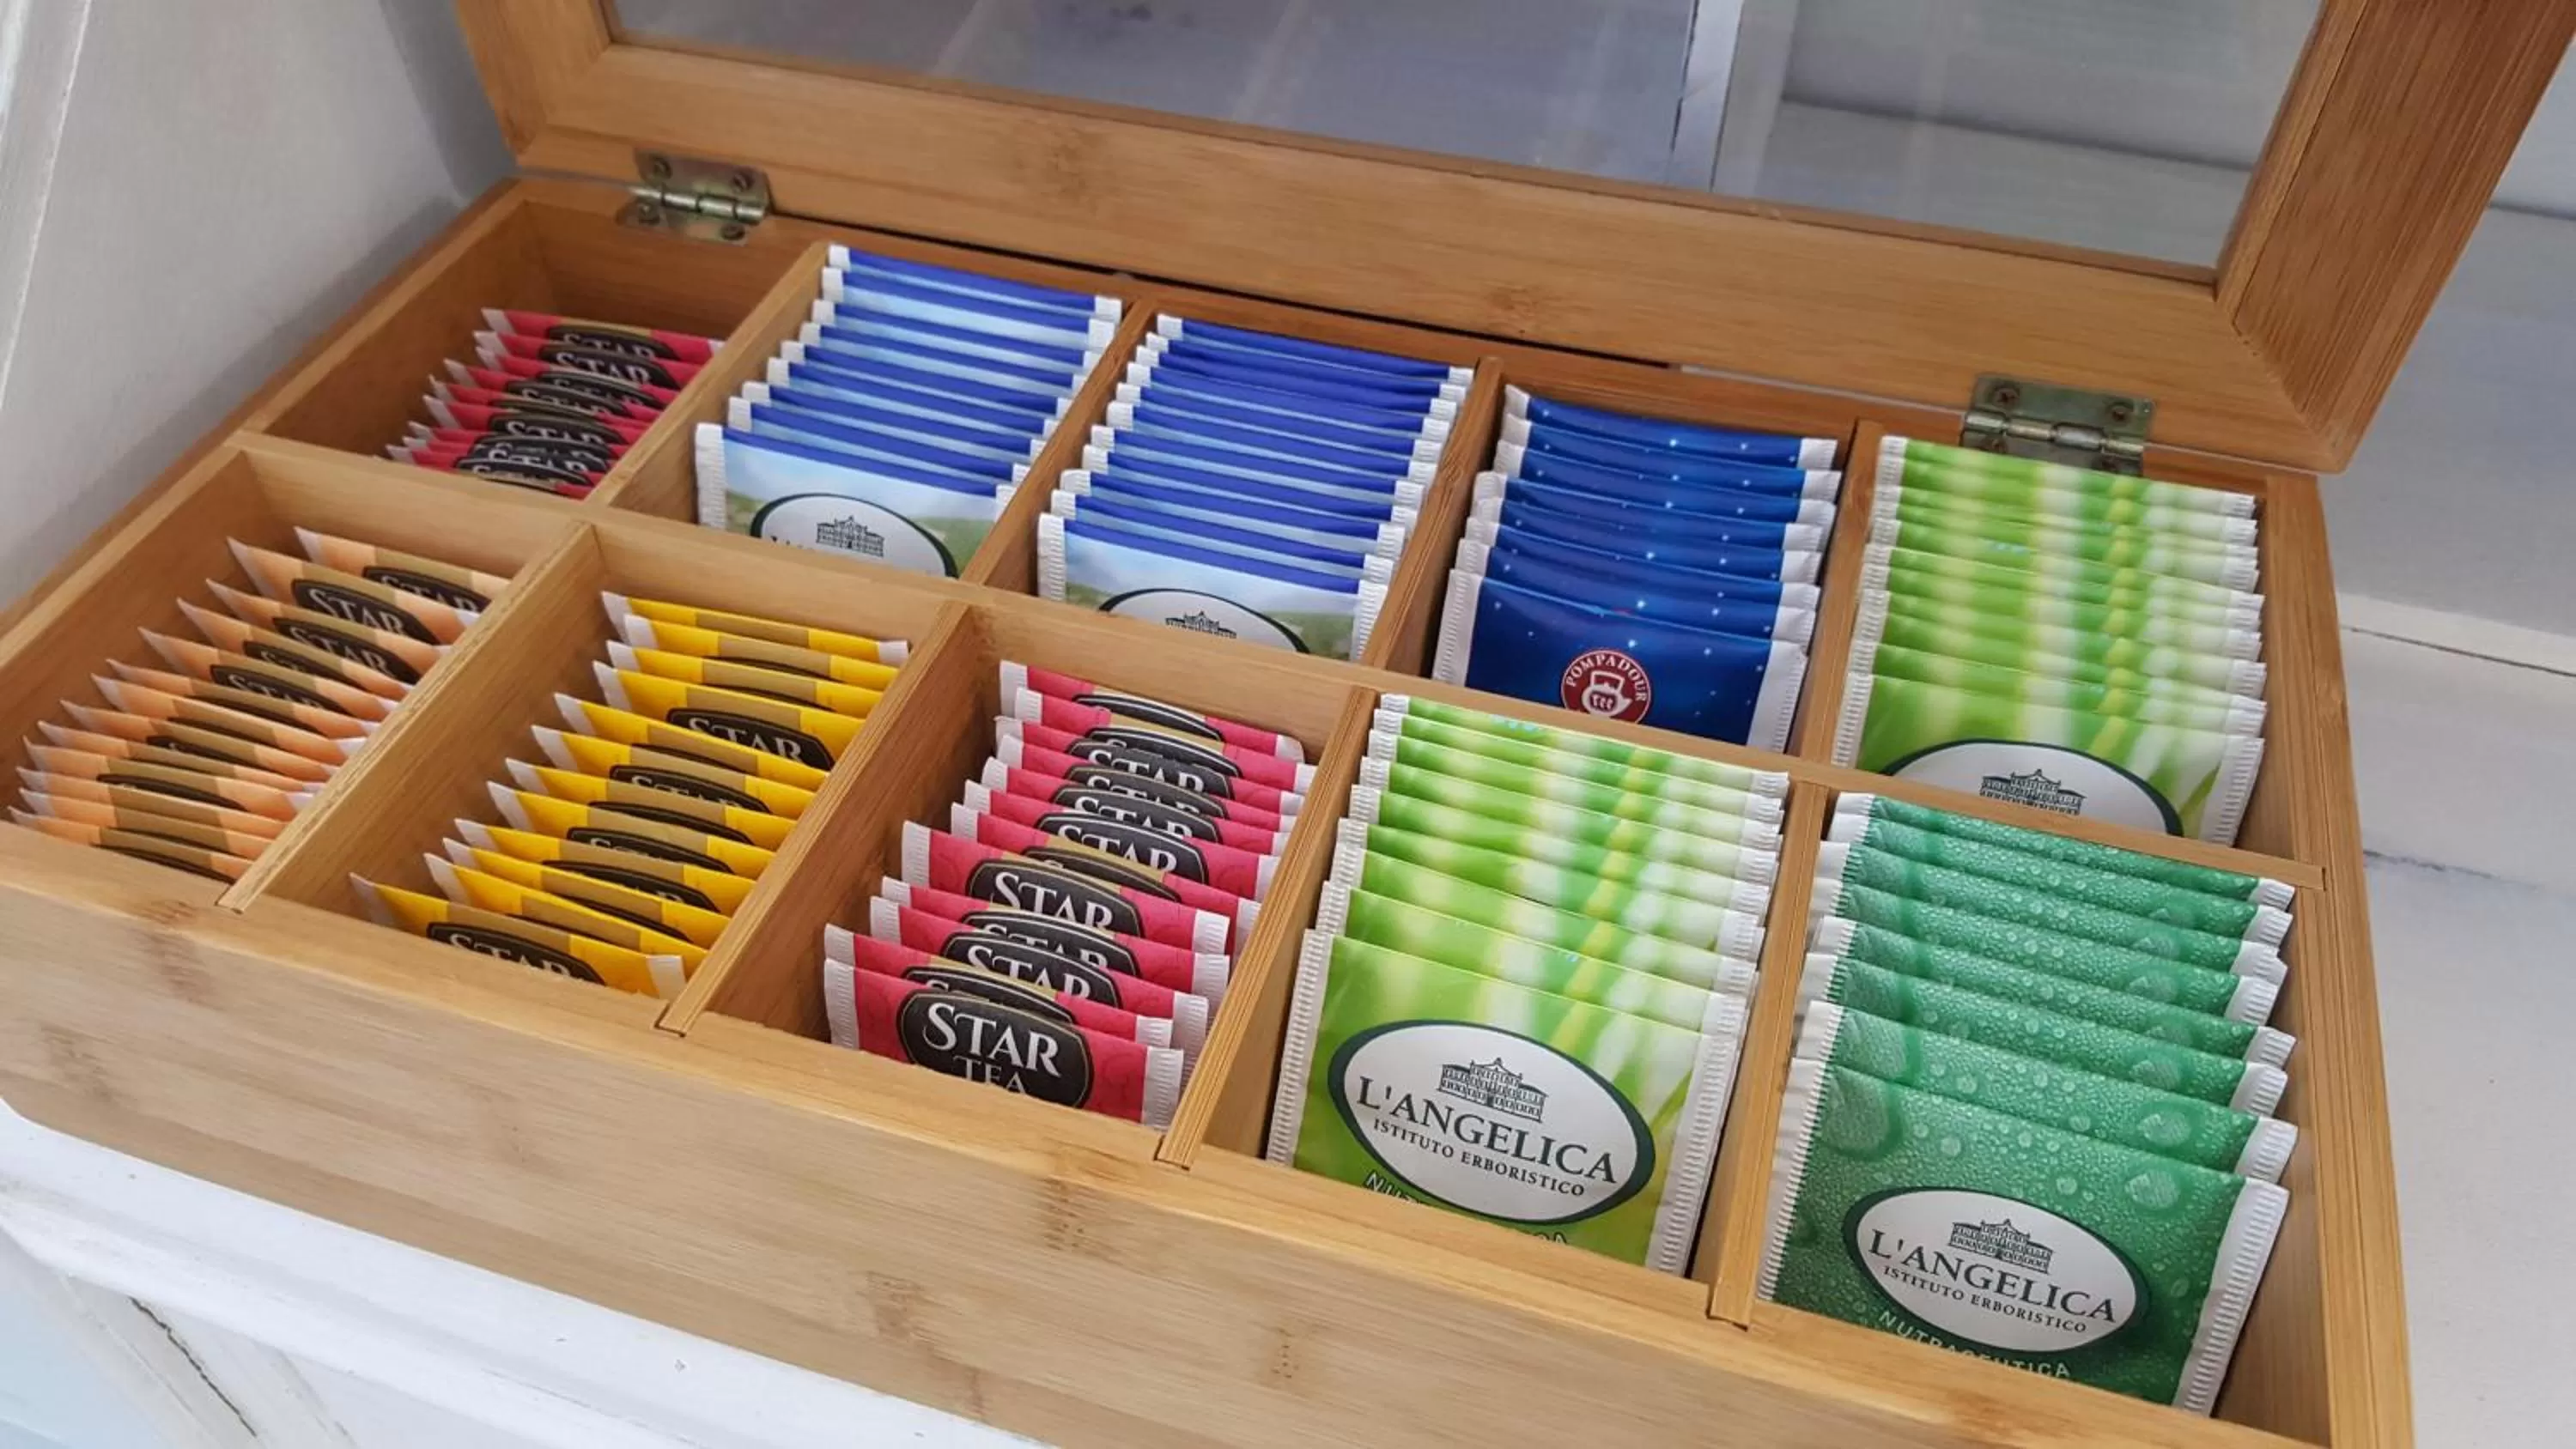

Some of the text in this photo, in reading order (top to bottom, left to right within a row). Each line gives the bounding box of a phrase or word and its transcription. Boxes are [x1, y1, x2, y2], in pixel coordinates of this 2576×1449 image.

[308, 588, 405, 635] STAR
[1565, 652, 1647, 702] POMPADOUR
[990, 871, 1113, 930] STAR
[922, 1003, 1060, 1078] STAR
[953, 1055, 1026, 1094] TEA
[1357, 1076, 1618, 1185] L'ANGELICA
[1374, 1119, 1455, 1158] ISTITUTO
[1460, 1152, 1585, 1197] ERBORISTICO
[1868, 1229, 2117, 1324] L'ANGELICA
[1883, 1265, 2087, 1334] ISTITUTO ERBORISTICO
